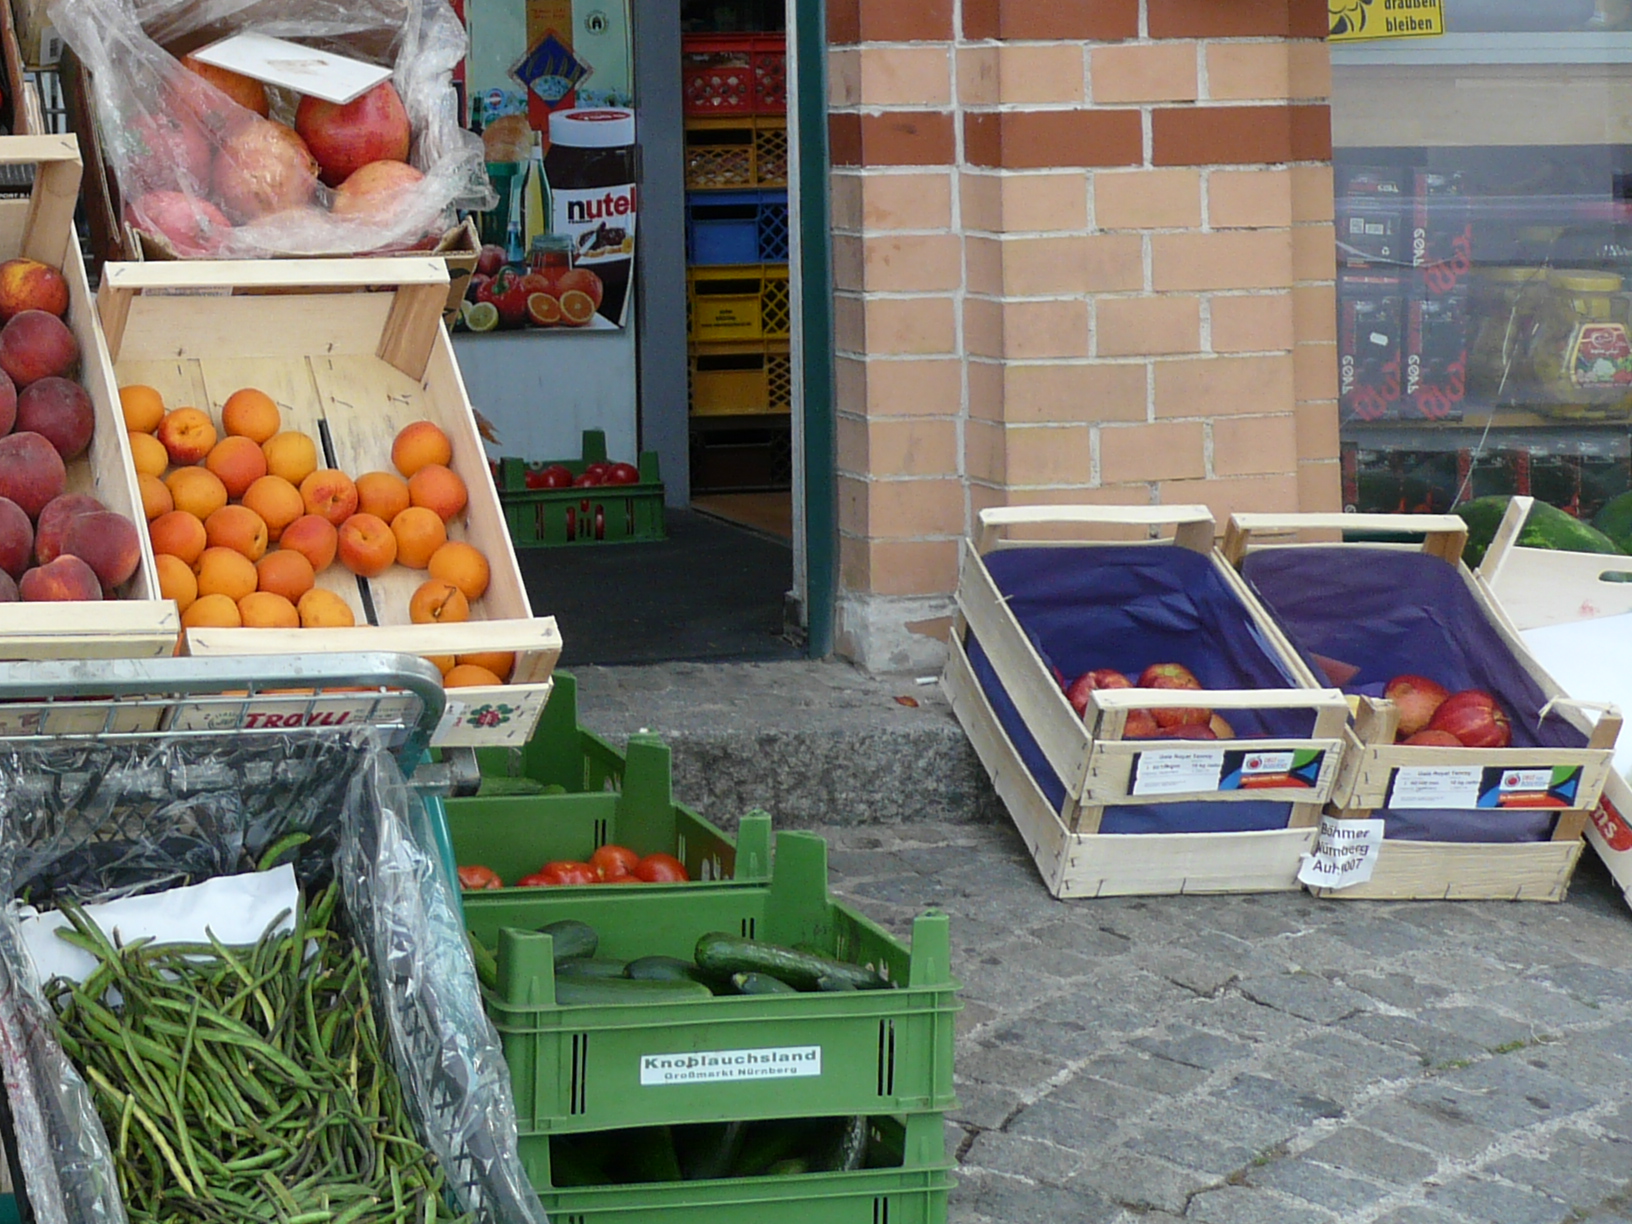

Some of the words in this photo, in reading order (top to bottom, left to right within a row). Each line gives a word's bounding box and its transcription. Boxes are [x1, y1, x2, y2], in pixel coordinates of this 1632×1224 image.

[1386, 16, 1433, 33] bleiben
[568, 186, 636, 219] nutel
[1321, 822, 1370, 839] Böhmer
[644, 1049, 817, 1069] Knoblauchsland
[664, 1069, 734, 1080] Großmarkt
[737, 1066, 798, 1076] Nürnberg
